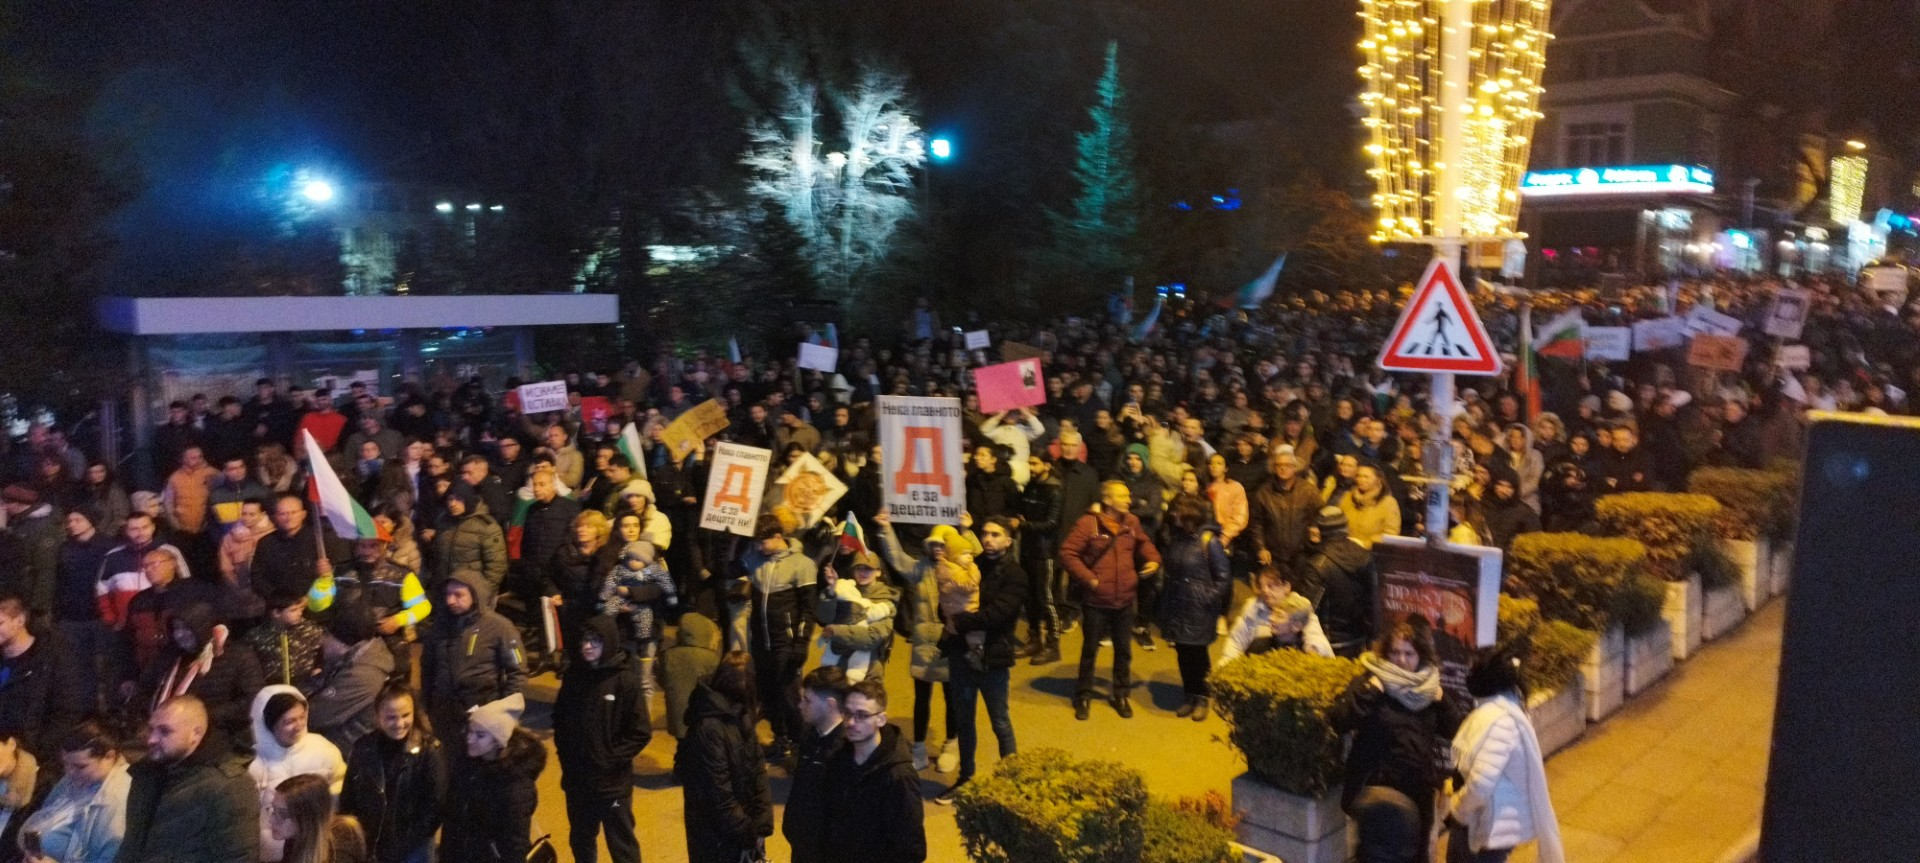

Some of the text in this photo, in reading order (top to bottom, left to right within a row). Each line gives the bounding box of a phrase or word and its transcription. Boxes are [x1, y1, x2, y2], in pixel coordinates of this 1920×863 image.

[525, 384, 566, 398] ИСКАМЕ
[882, 403, 961, 417] Нека главното
[894, 426, 953, 497] Д
[713, 464, 752, 513] Д
[911, 490, 939, 502] е за
[889, 504, 938, 518] децата
[705, 513, 753, 529] децата ни!
